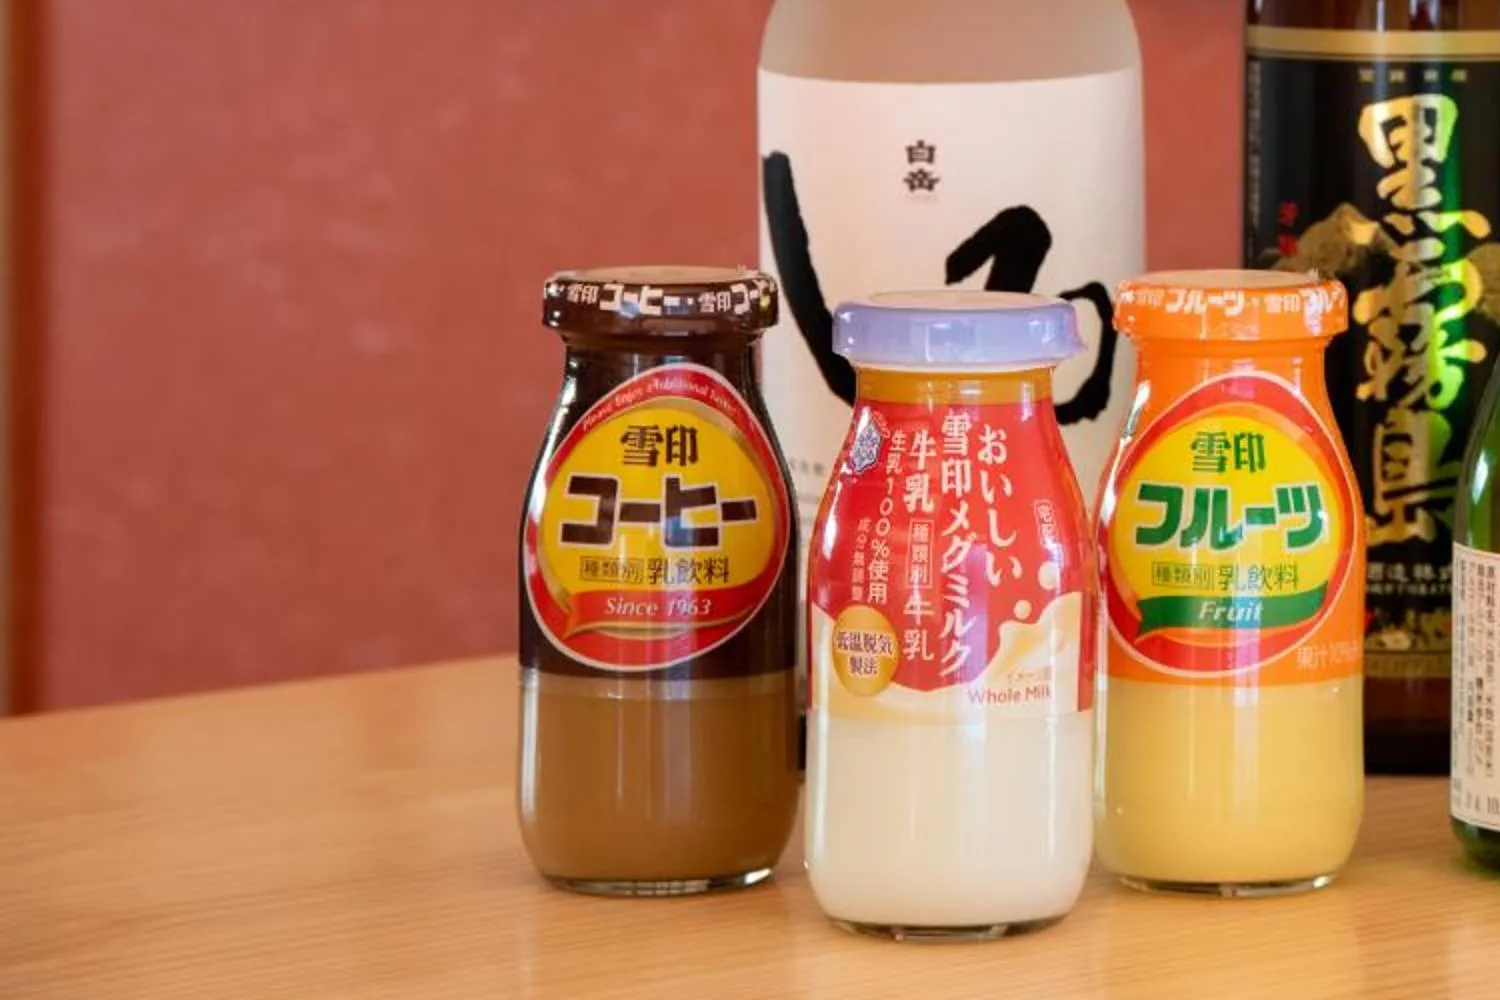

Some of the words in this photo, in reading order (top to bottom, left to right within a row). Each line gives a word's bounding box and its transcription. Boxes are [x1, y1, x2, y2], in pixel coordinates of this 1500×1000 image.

[903, 139, 941, 194] 白岳
[619, 425, 700, 467] 雪印
[1190, 431, 1266, 473] 雪印
[902, 428, 937, 514] 牛乳
[558, 472, 760, 549] コーヒー
[977, 422, 1024, 588] おいしい
[1135, 483, 1328, 552] フルーツ
[938, 410, 982, 680] 雪印メグミルク
[646, 555, 731, 585] 乳飲料
[1215, 561, 1299, 592] 乳飲料
[604, 596, 660, 617] Since
[666, 599, 713, 617] 1963
[1197, 601, 1264, 622] Fruit
